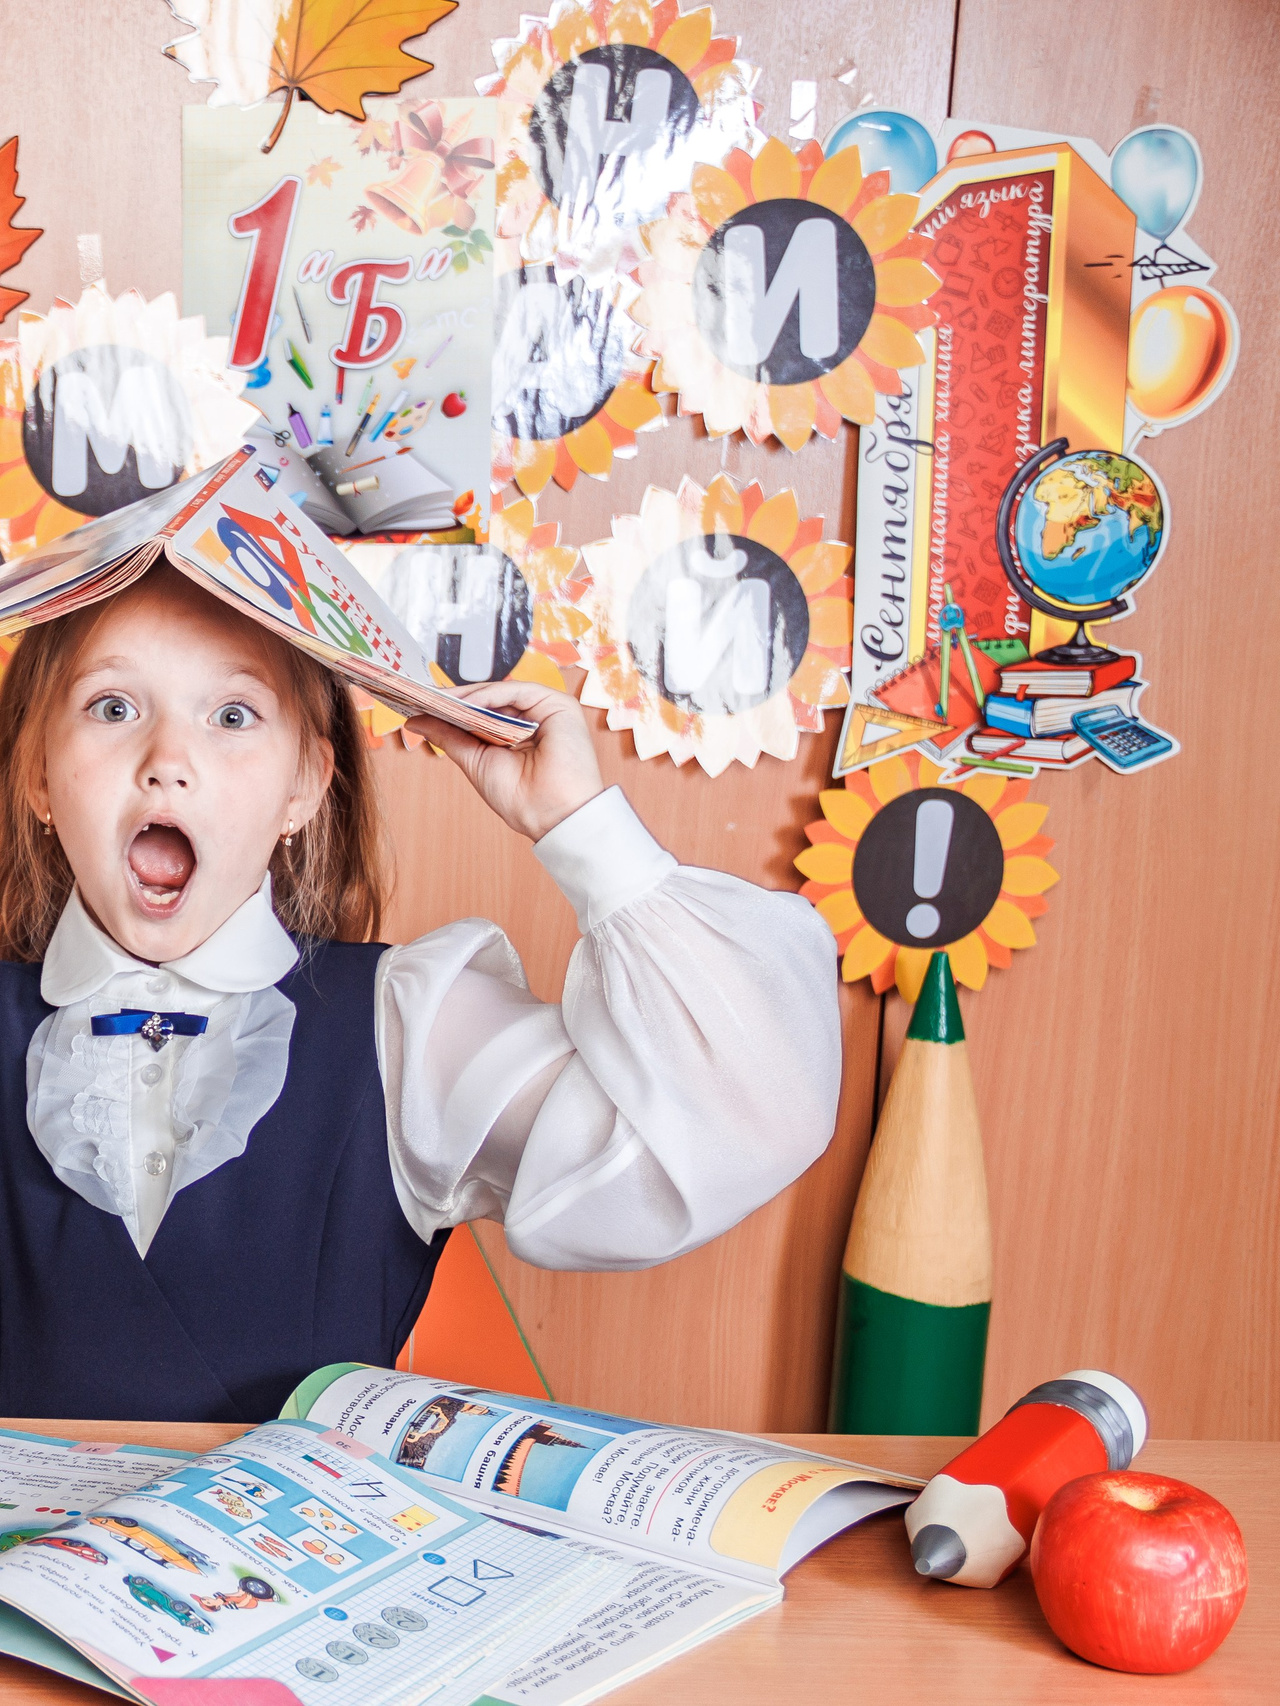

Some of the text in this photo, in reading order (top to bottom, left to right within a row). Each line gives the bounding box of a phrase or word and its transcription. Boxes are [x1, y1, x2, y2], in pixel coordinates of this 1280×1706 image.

[227, 175, 303, 371] 1
[722, 218, 838, 364] И
[1016, 180, 1054, 378] литература
[52, 370, 173, 497] М
[859, 374, 934, 671] Сентября
[925, 429, 951, 643] математика
[272, 506, 404, 661] Русский
[327, 585, 412, 679] язы
[382, 1398, 417, 1435] Зоопарк
[474, 1450, 496, 1489] башня
[592, 1447, 629, 1483] Москве!
[602, 1470, 634, 1524] Москва?
[614, 1462, 659, 1526] Подумайте,
[684, 1475, 712, 1505] жизни
[321, 1489, 355, 1512] можно
[630, 1467, 670, 1529] вы знаете.
[99, 1584, 151, 1623] прибавить
